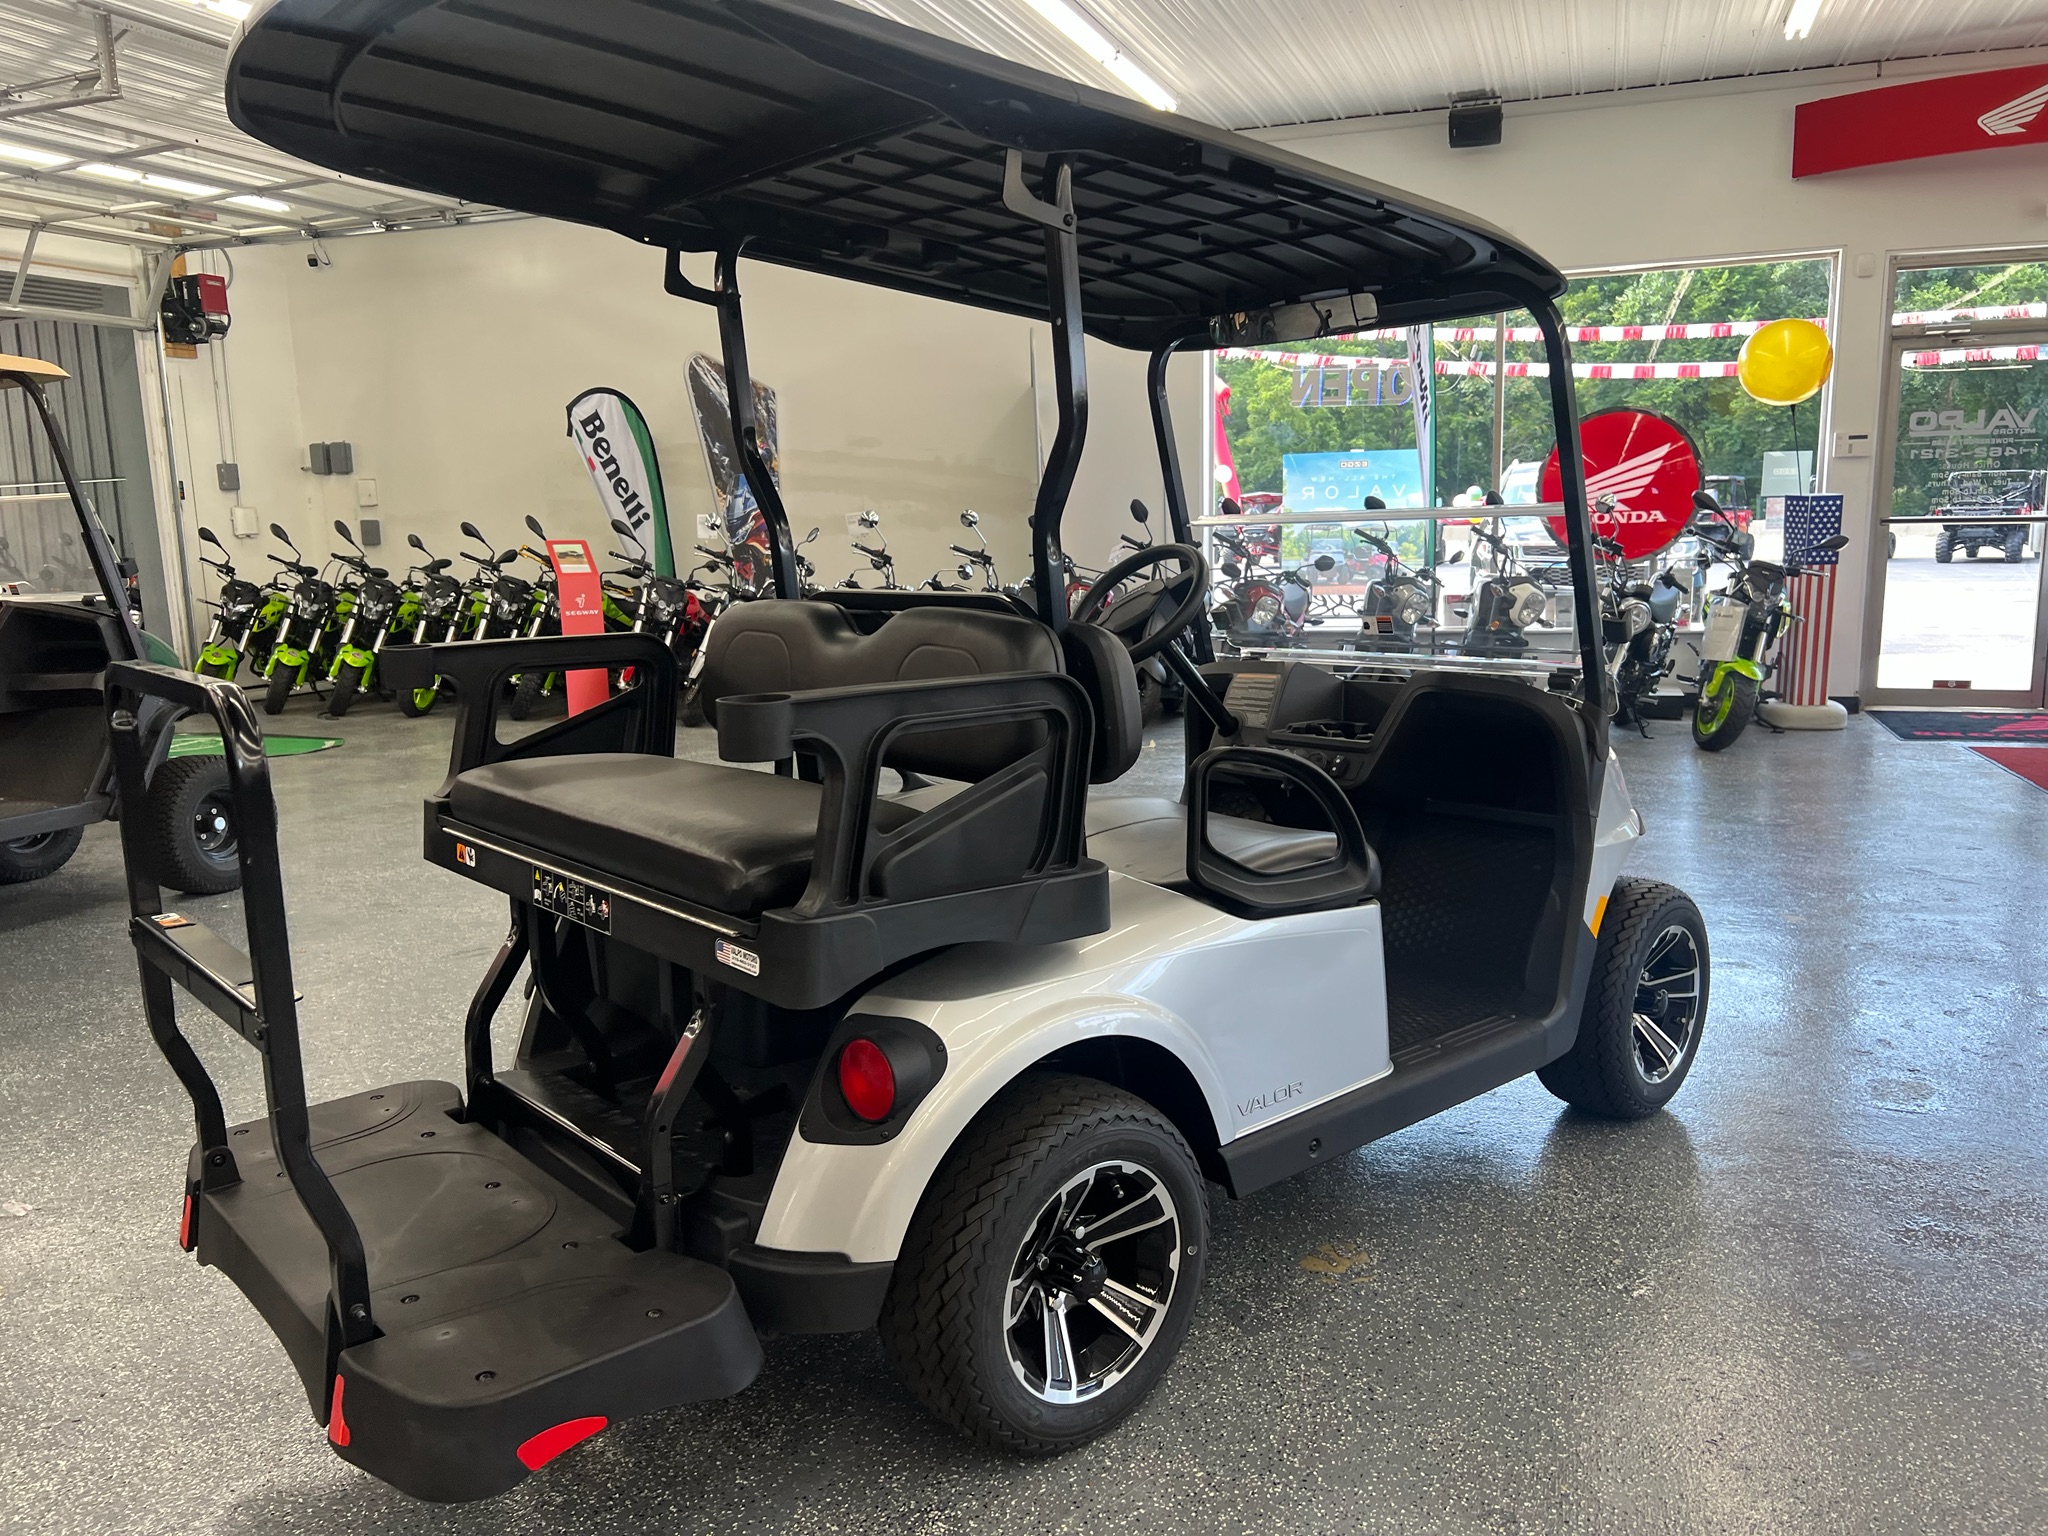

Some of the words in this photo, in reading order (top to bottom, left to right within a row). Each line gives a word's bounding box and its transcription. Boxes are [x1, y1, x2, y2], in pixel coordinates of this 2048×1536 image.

[579, 409, 650, 532] Benelli
[1590, 510, 1667, 524] ONDA
[1237, 1081, 1303, 1116] VALOR
